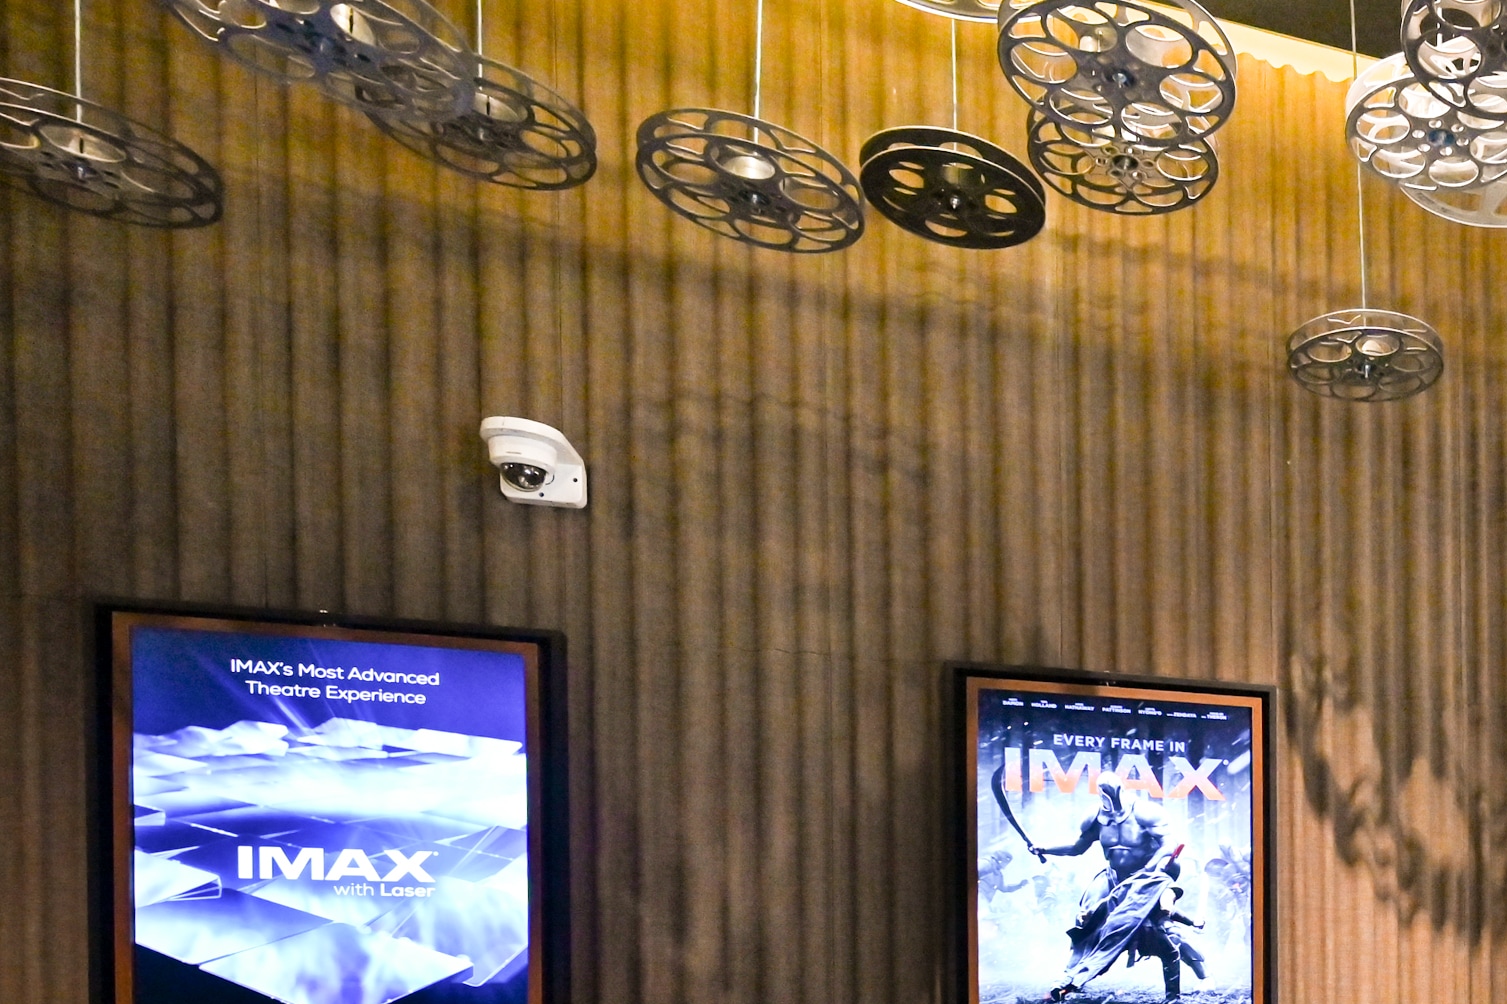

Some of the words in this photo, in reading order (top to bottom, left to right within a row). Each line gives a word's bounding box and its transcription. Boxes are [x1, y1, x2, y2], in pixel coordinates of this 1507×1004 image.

[231, 658, 294, 677] IMAX's
[298, 663, 344, 680] Most
[348, 667, 440, 686] Advanced
[245, 680, 321, 698] Theatre
[326, 685, 426, 705] Experience
[1053, 734, 1105, 748] EVERY
[1111, 737, 1164, 751] FRAME
[1169, 741, 1185, 752] IN
[1004, 747, 1226, 801] IMAX
[238, 846, 436, 882] IMAX
[334, 883, 374, 897] with
[380, 883, 436, 897] Laser
